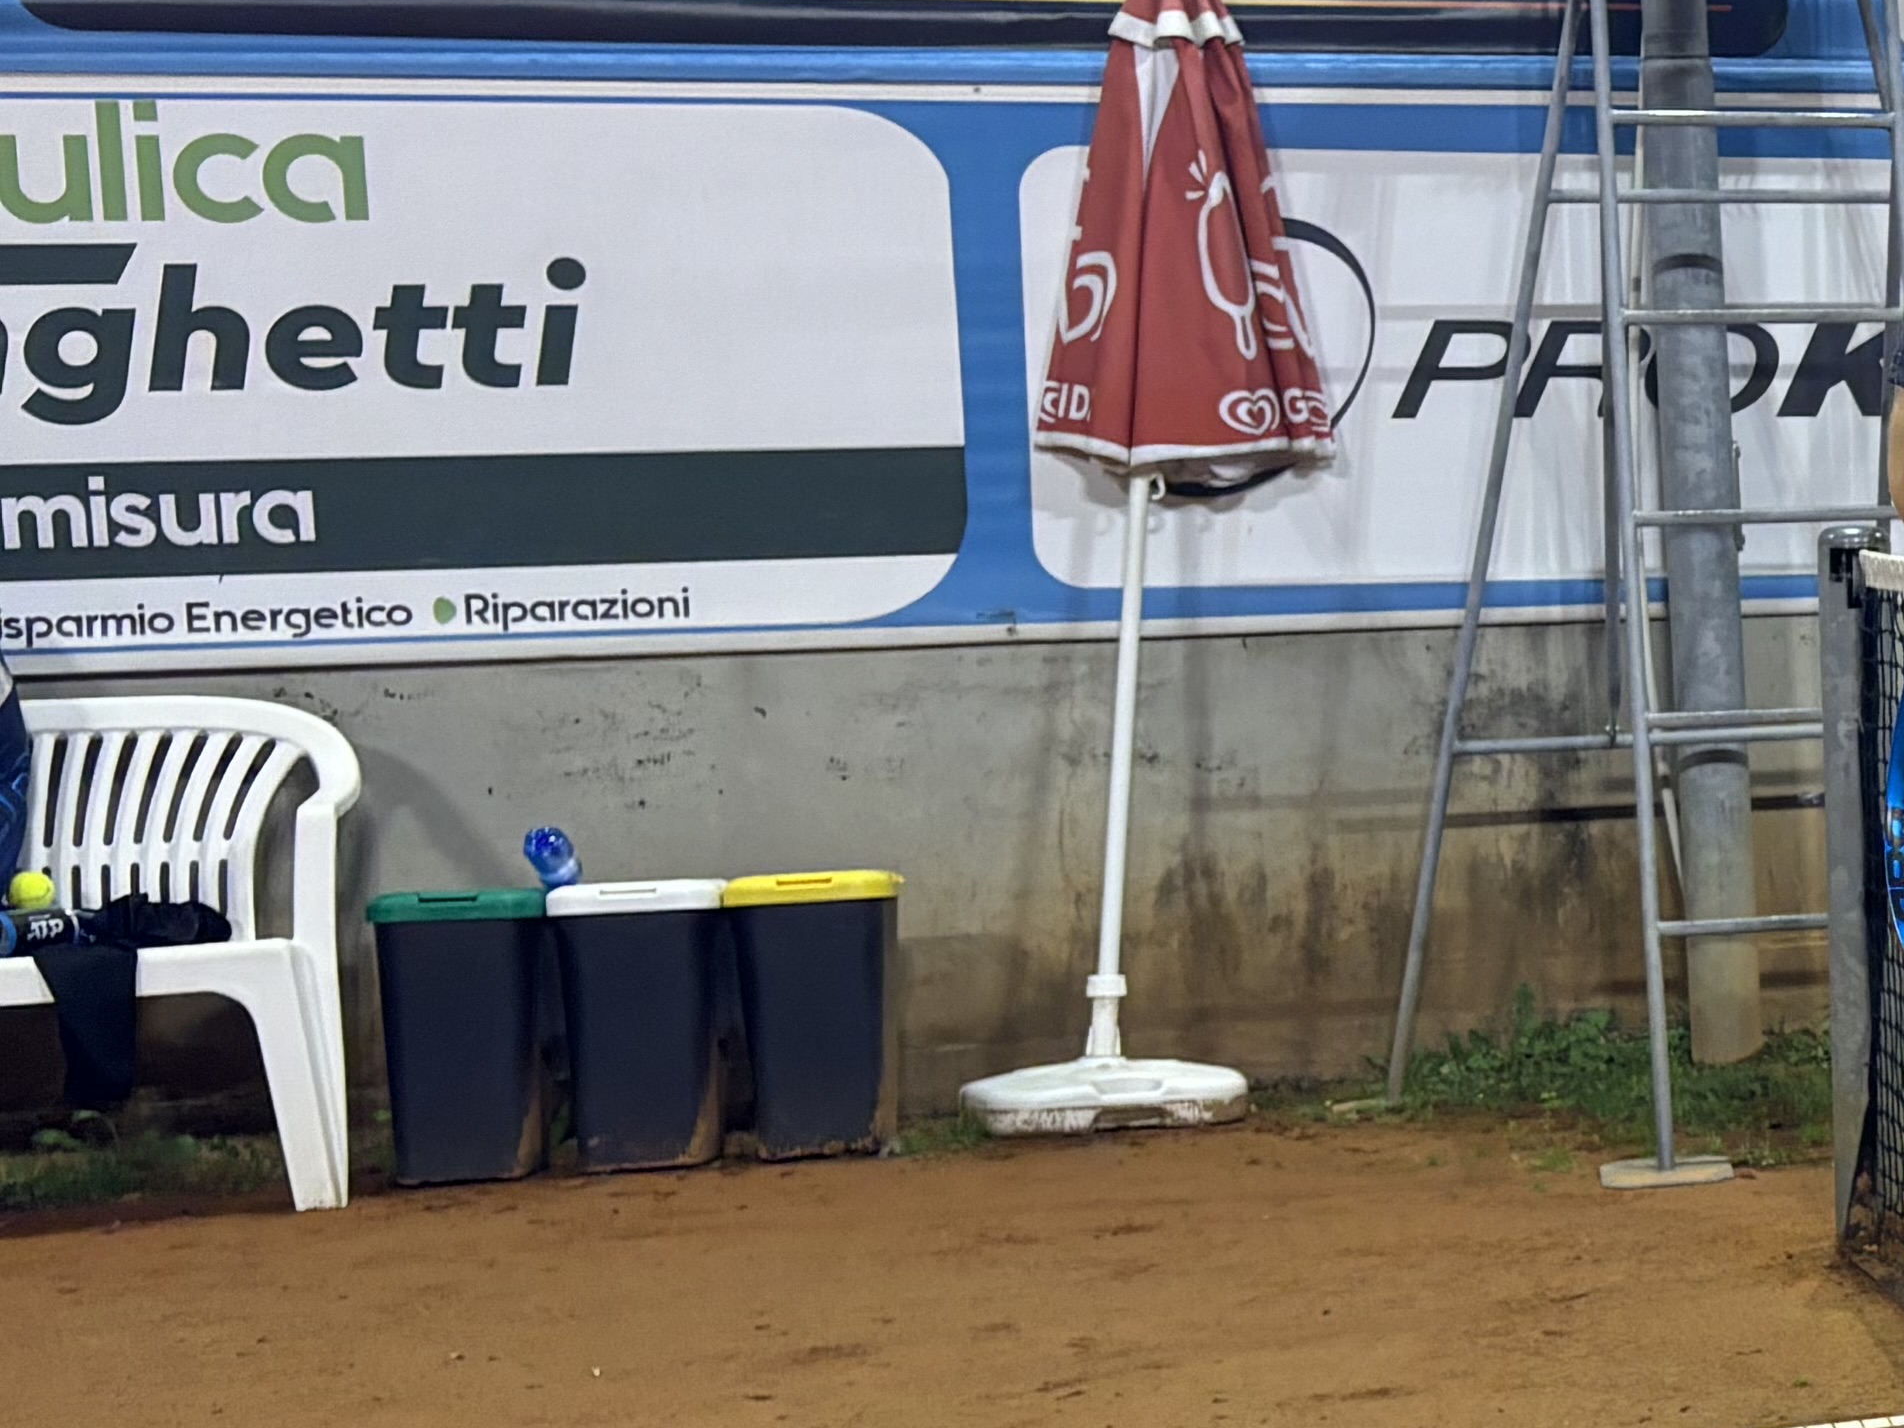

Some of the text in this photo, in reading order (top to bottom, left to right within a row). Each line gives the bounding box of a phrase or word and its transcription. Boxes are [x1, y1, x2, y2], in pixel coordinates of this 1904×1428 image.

[0, 256, 587, 426] ghetti
[1, 476, 316, 550] misura
[0, 586, 691, 648] sparmio Energetico Riparazioni
